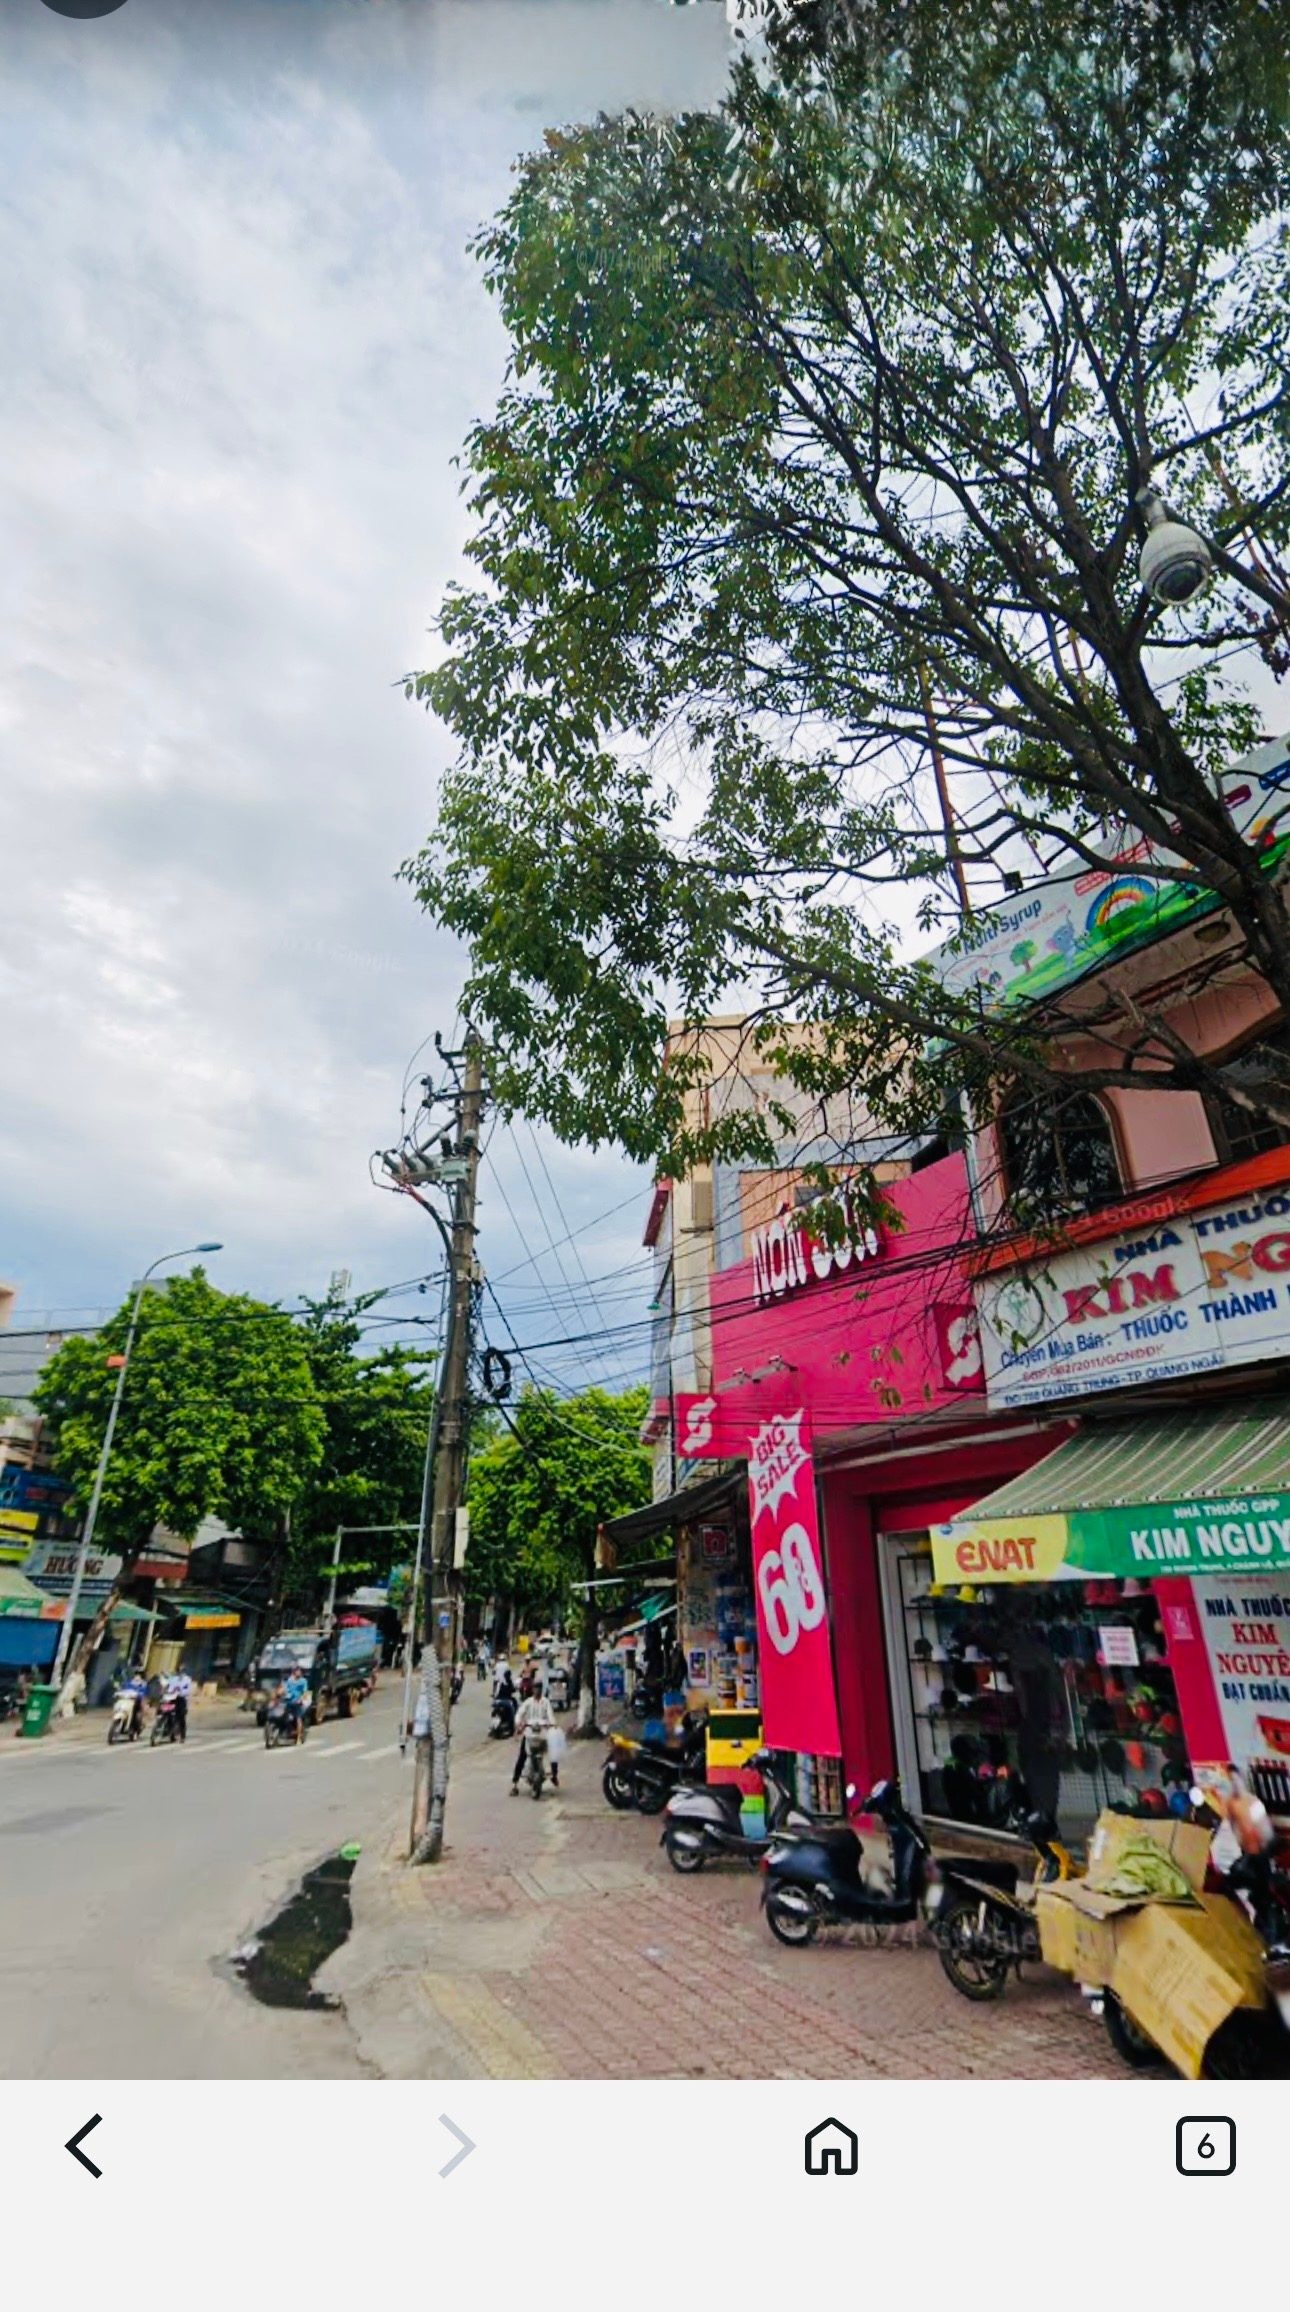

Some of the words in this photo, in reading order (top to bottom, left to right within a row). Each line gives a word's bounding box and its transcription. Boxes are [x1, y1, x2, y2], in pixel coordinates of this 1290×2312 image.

[1000, 898, 1041, 933] Syrup
[1062, 1263, 1181, 1325] KIM
[1120, 1304, 1189, 1342] THUỐC
[1199, 1288, 1278, 1324] THÀNH
[757, 1421, 785, 1465] BIG
[758, 1439, 800, 1499] SALE
[1173, 1503, 1201, 1519] NHÀ
[1202, 1498, 1249, 1516] THUỐC
[956, 1538, 1036, 1573] ENAT
[1130, 1526, 1191, 1561] KIM
[1196, 1518, 1290, 1557] NGUY
[1205, 1595, 1238, 1617] NHÀ
[1231, 1623, 1279, 1645] KIM
[1197, 2132, 1215, 2159] 6
